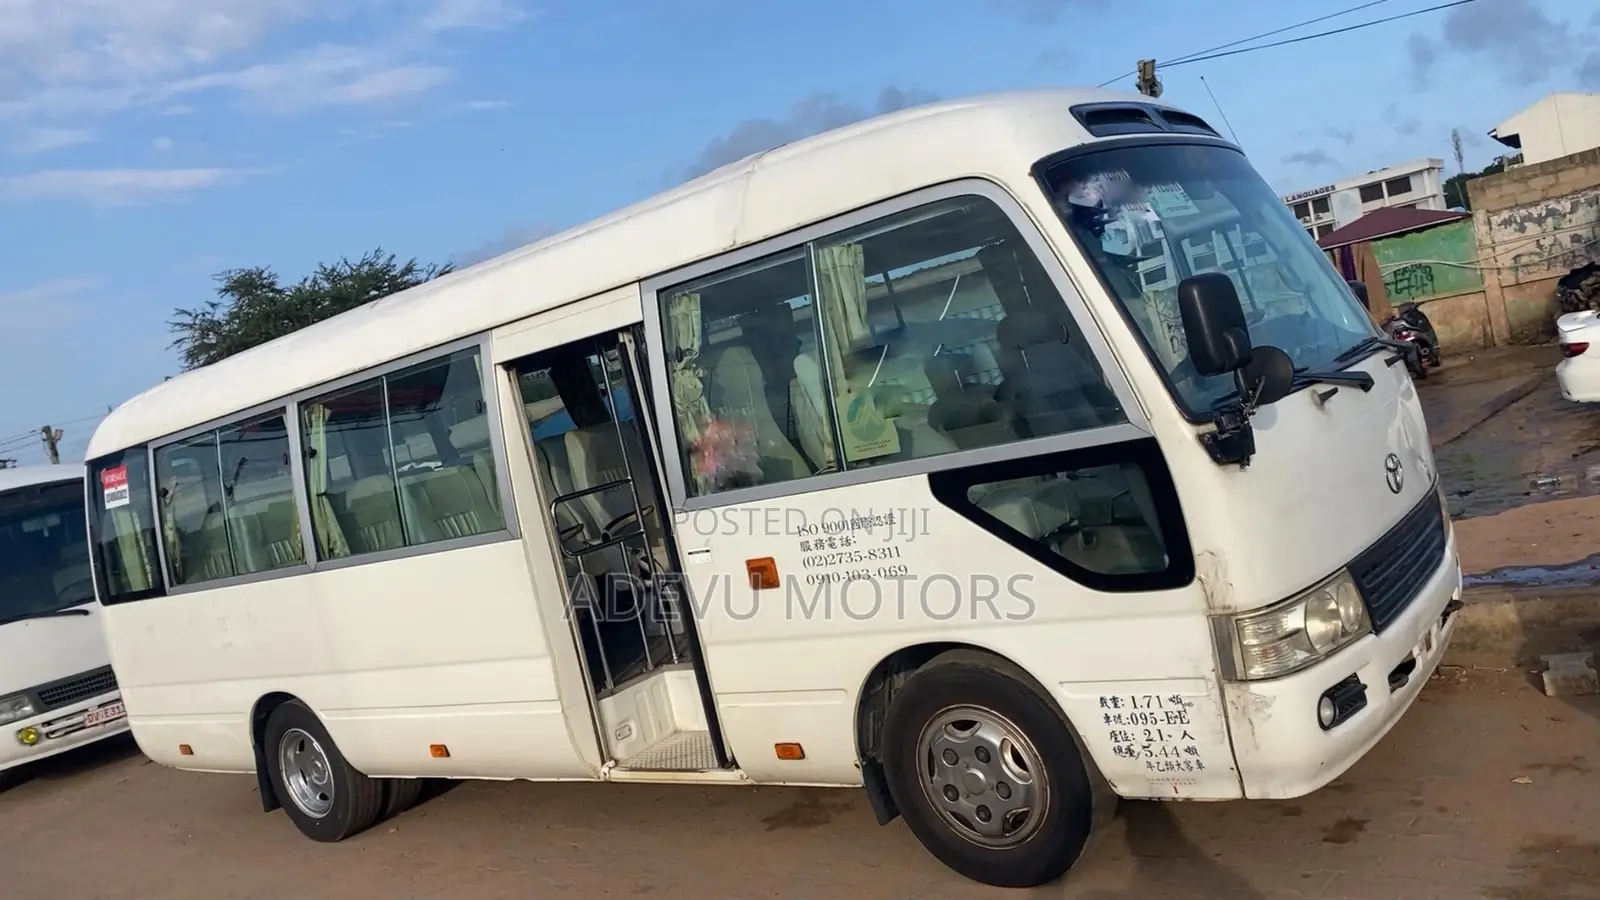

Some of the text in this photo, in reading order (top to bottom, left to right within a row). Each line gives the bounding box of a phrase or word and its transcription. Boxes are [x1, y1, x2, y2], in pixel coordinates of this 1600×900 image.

[1285, 185, 1336, 202] LANGUAGES
[797, 522, 819, 538] ISO
[802, 545, 902, 570] (02)2735-8311
[806, 564, 909, 587] 0910-103-069
[1131, 694, 1165, 710] 1.71
[1142, 743, 1182, 759] 5.44
